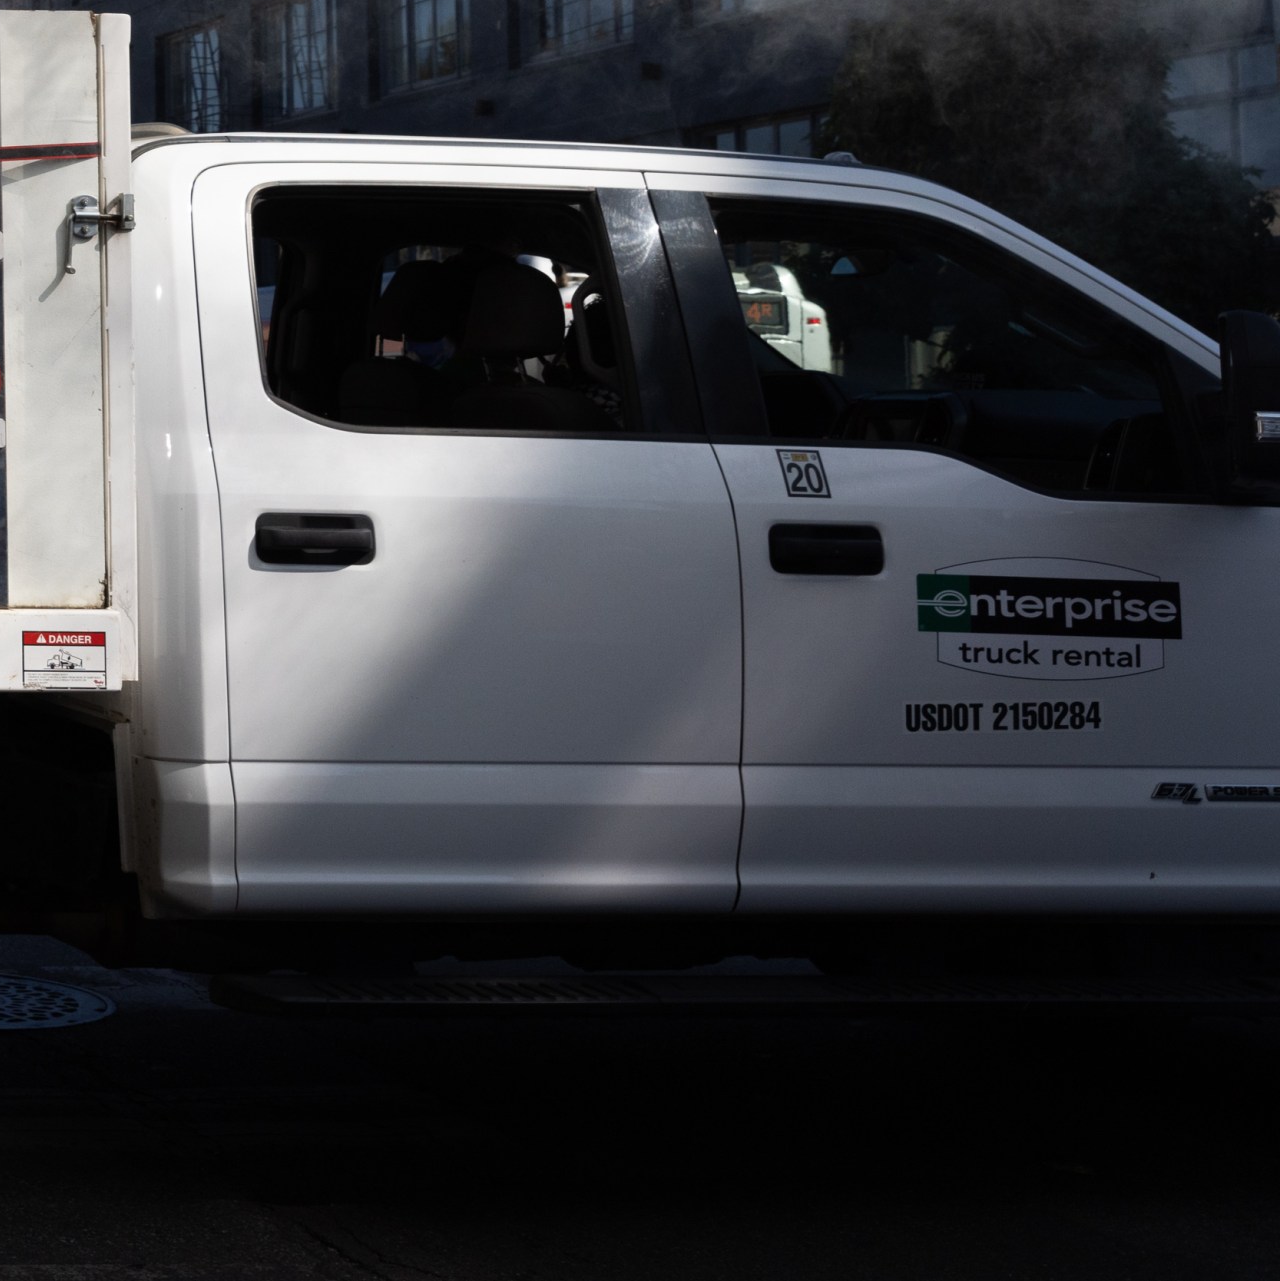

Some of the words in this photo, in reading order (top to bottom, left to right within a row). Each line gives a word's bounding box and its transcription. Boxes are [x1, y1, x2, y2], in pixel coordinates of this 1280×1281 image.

[787, 462, 823, 493] 20
[933, 590, 1177, 628] enterprise
[48, 635, 92, 644] DANGER
[958, 641, 1040, 665] truck
[1051, 643, 1141, 668] rental
[905, 703, 984, 732] USDOT
[992, 701, 1101, 732] 2150284
[1211, 785, 1269, 797] POWER
